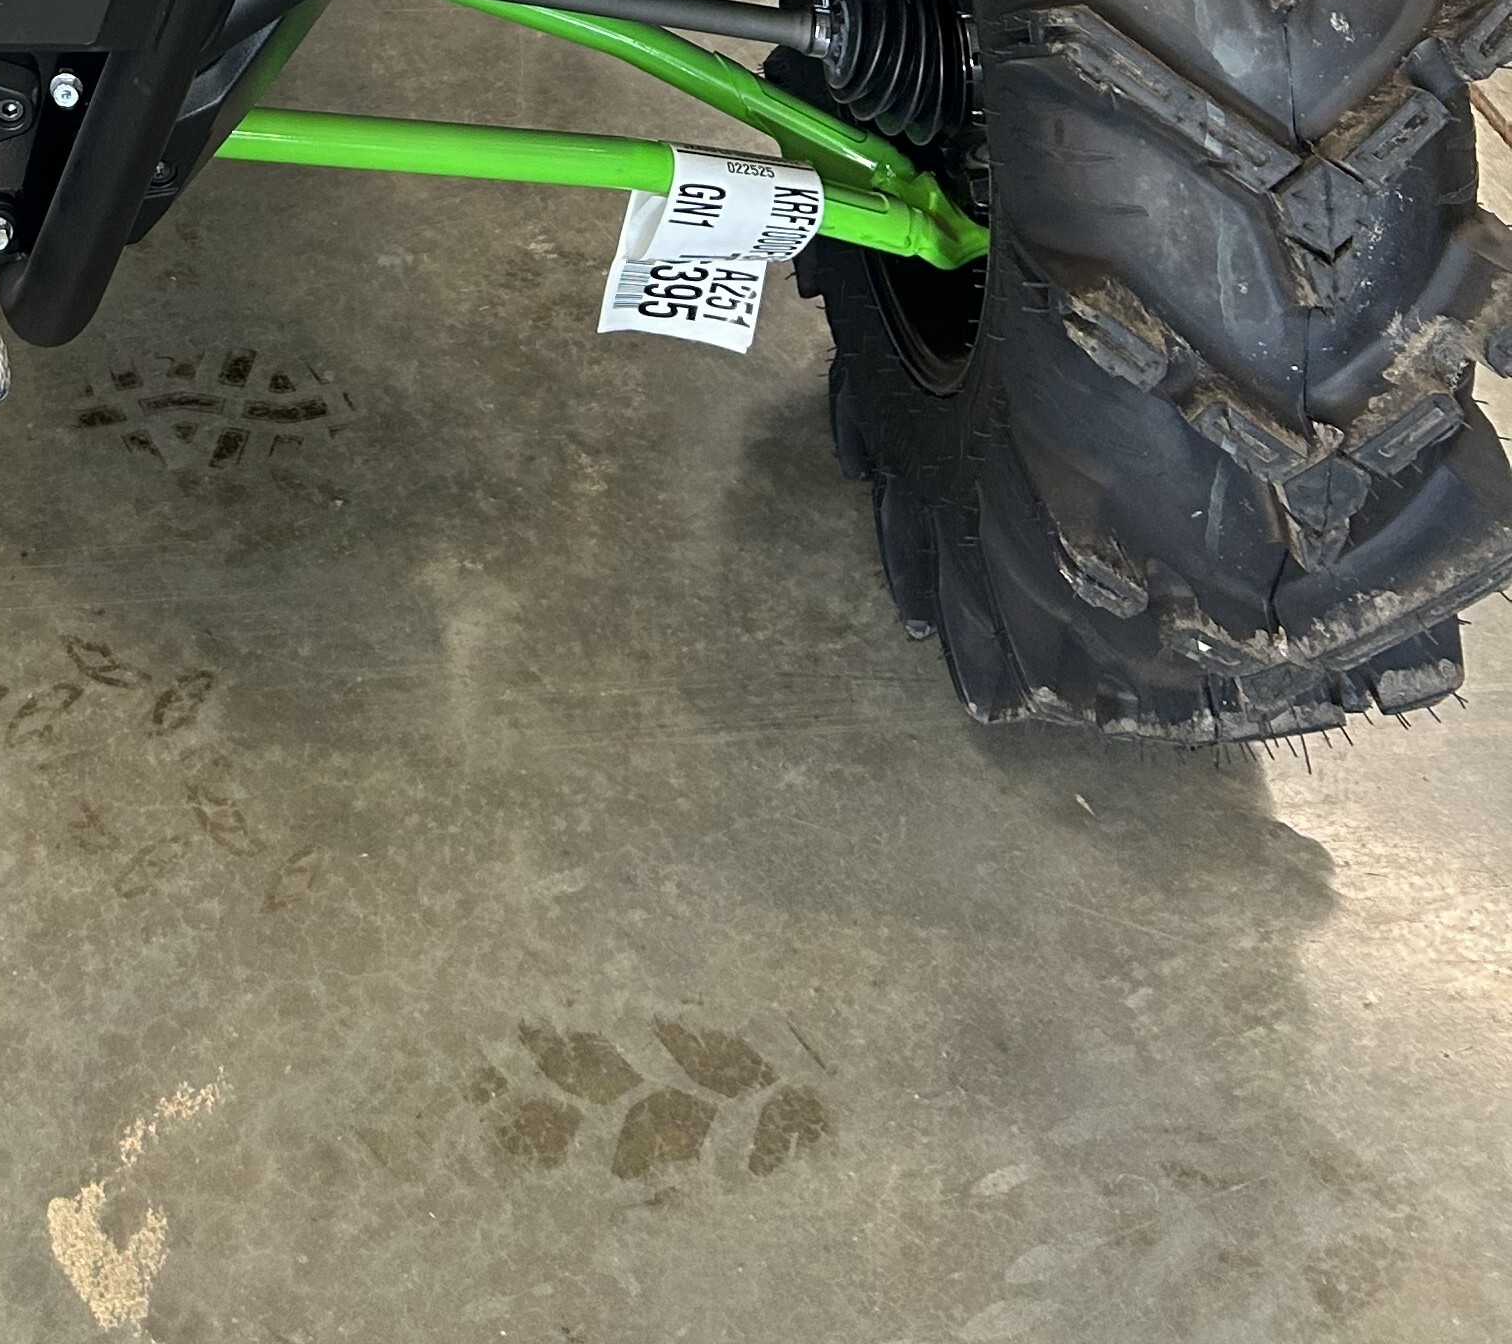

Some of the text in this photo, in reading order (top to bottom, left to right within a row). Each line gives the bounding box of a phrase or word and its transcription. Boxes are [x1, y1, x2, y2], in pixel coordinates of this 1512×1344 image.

[726, 161, 776, 179] 022525
[668, 183, 727, 229] GN1
[637, 260, 710, 322] 395
[702, 267, 760, 329] A251
